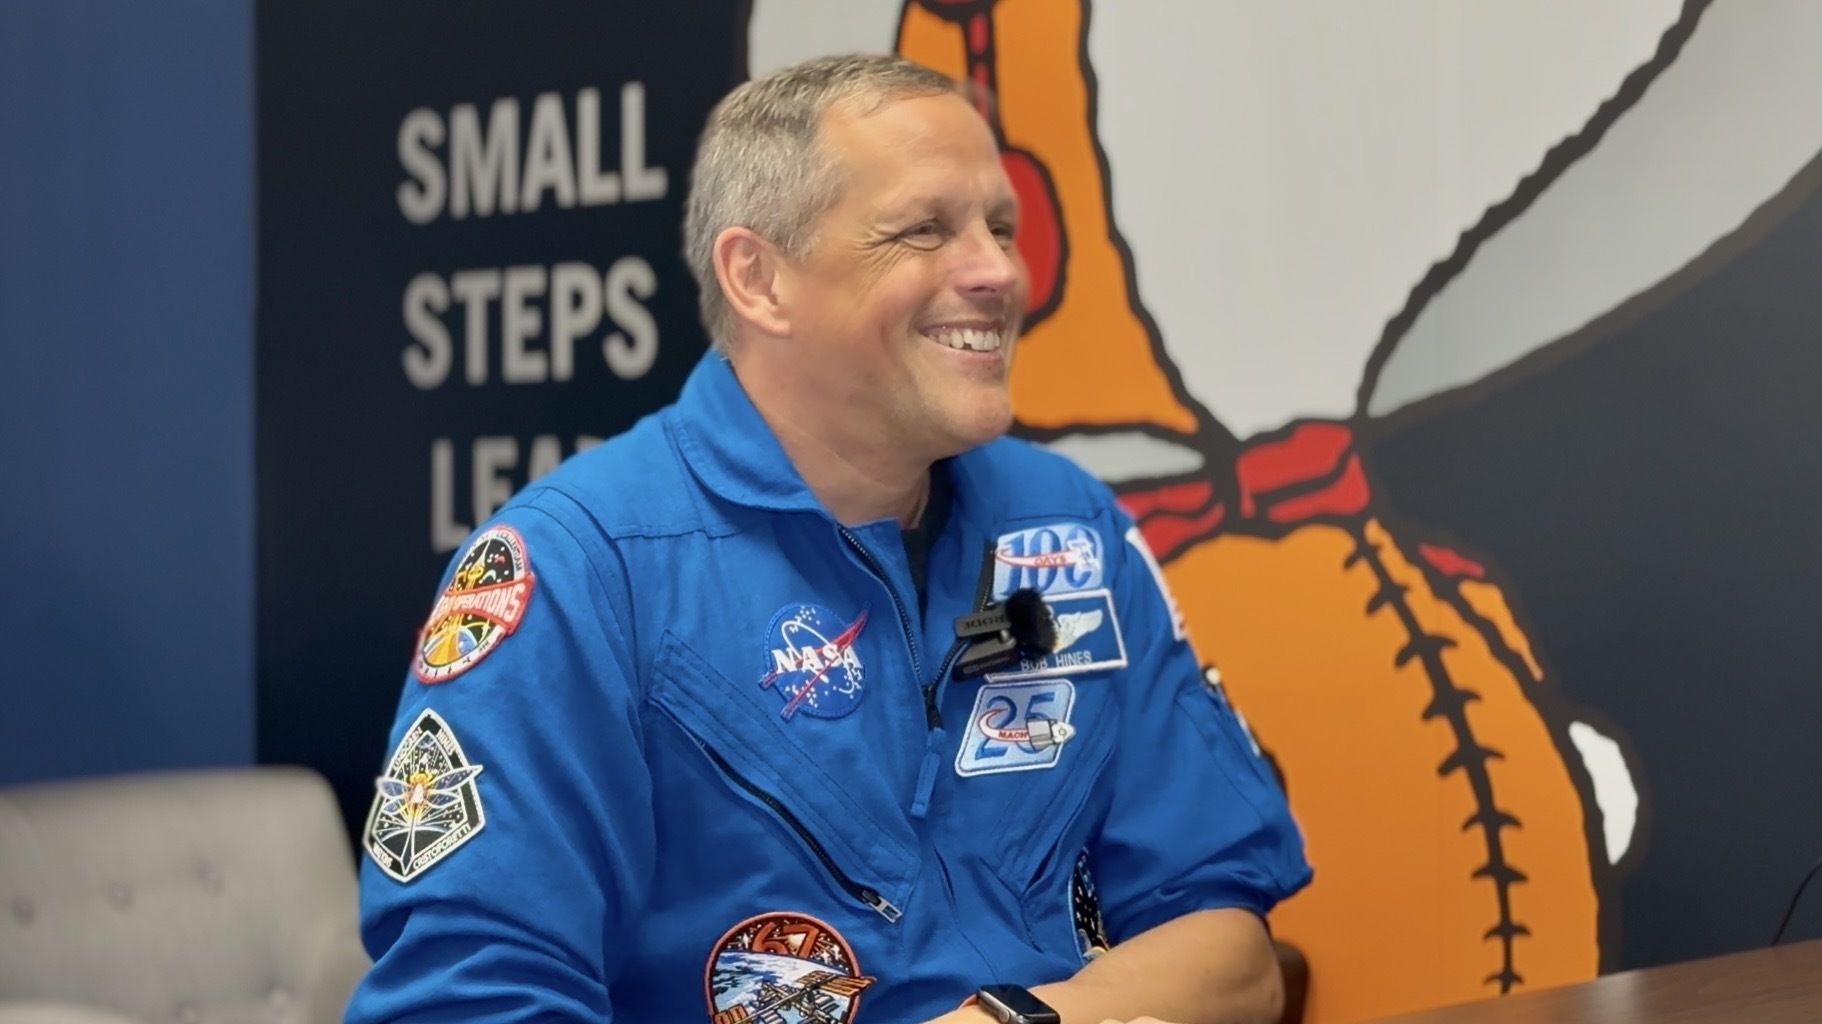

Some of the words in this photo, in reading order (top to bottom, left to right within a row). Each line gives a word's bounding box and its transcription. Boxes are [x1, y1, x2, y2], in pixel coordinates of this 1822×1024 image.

[398, 81, 668, 225] SMALL
[402, 256, 659, 390] STEPS
[431, 436, 603, 552] LE
[771, 645, 864, 674] NASA
[1019, 656, 1049, 673] BOB
[1055, 650, 1093, 668] HINES
[974, 691, 1056, 761] 25
[998, 730, 1029, 740] MACH
[751, 921, 820, 958] 67
